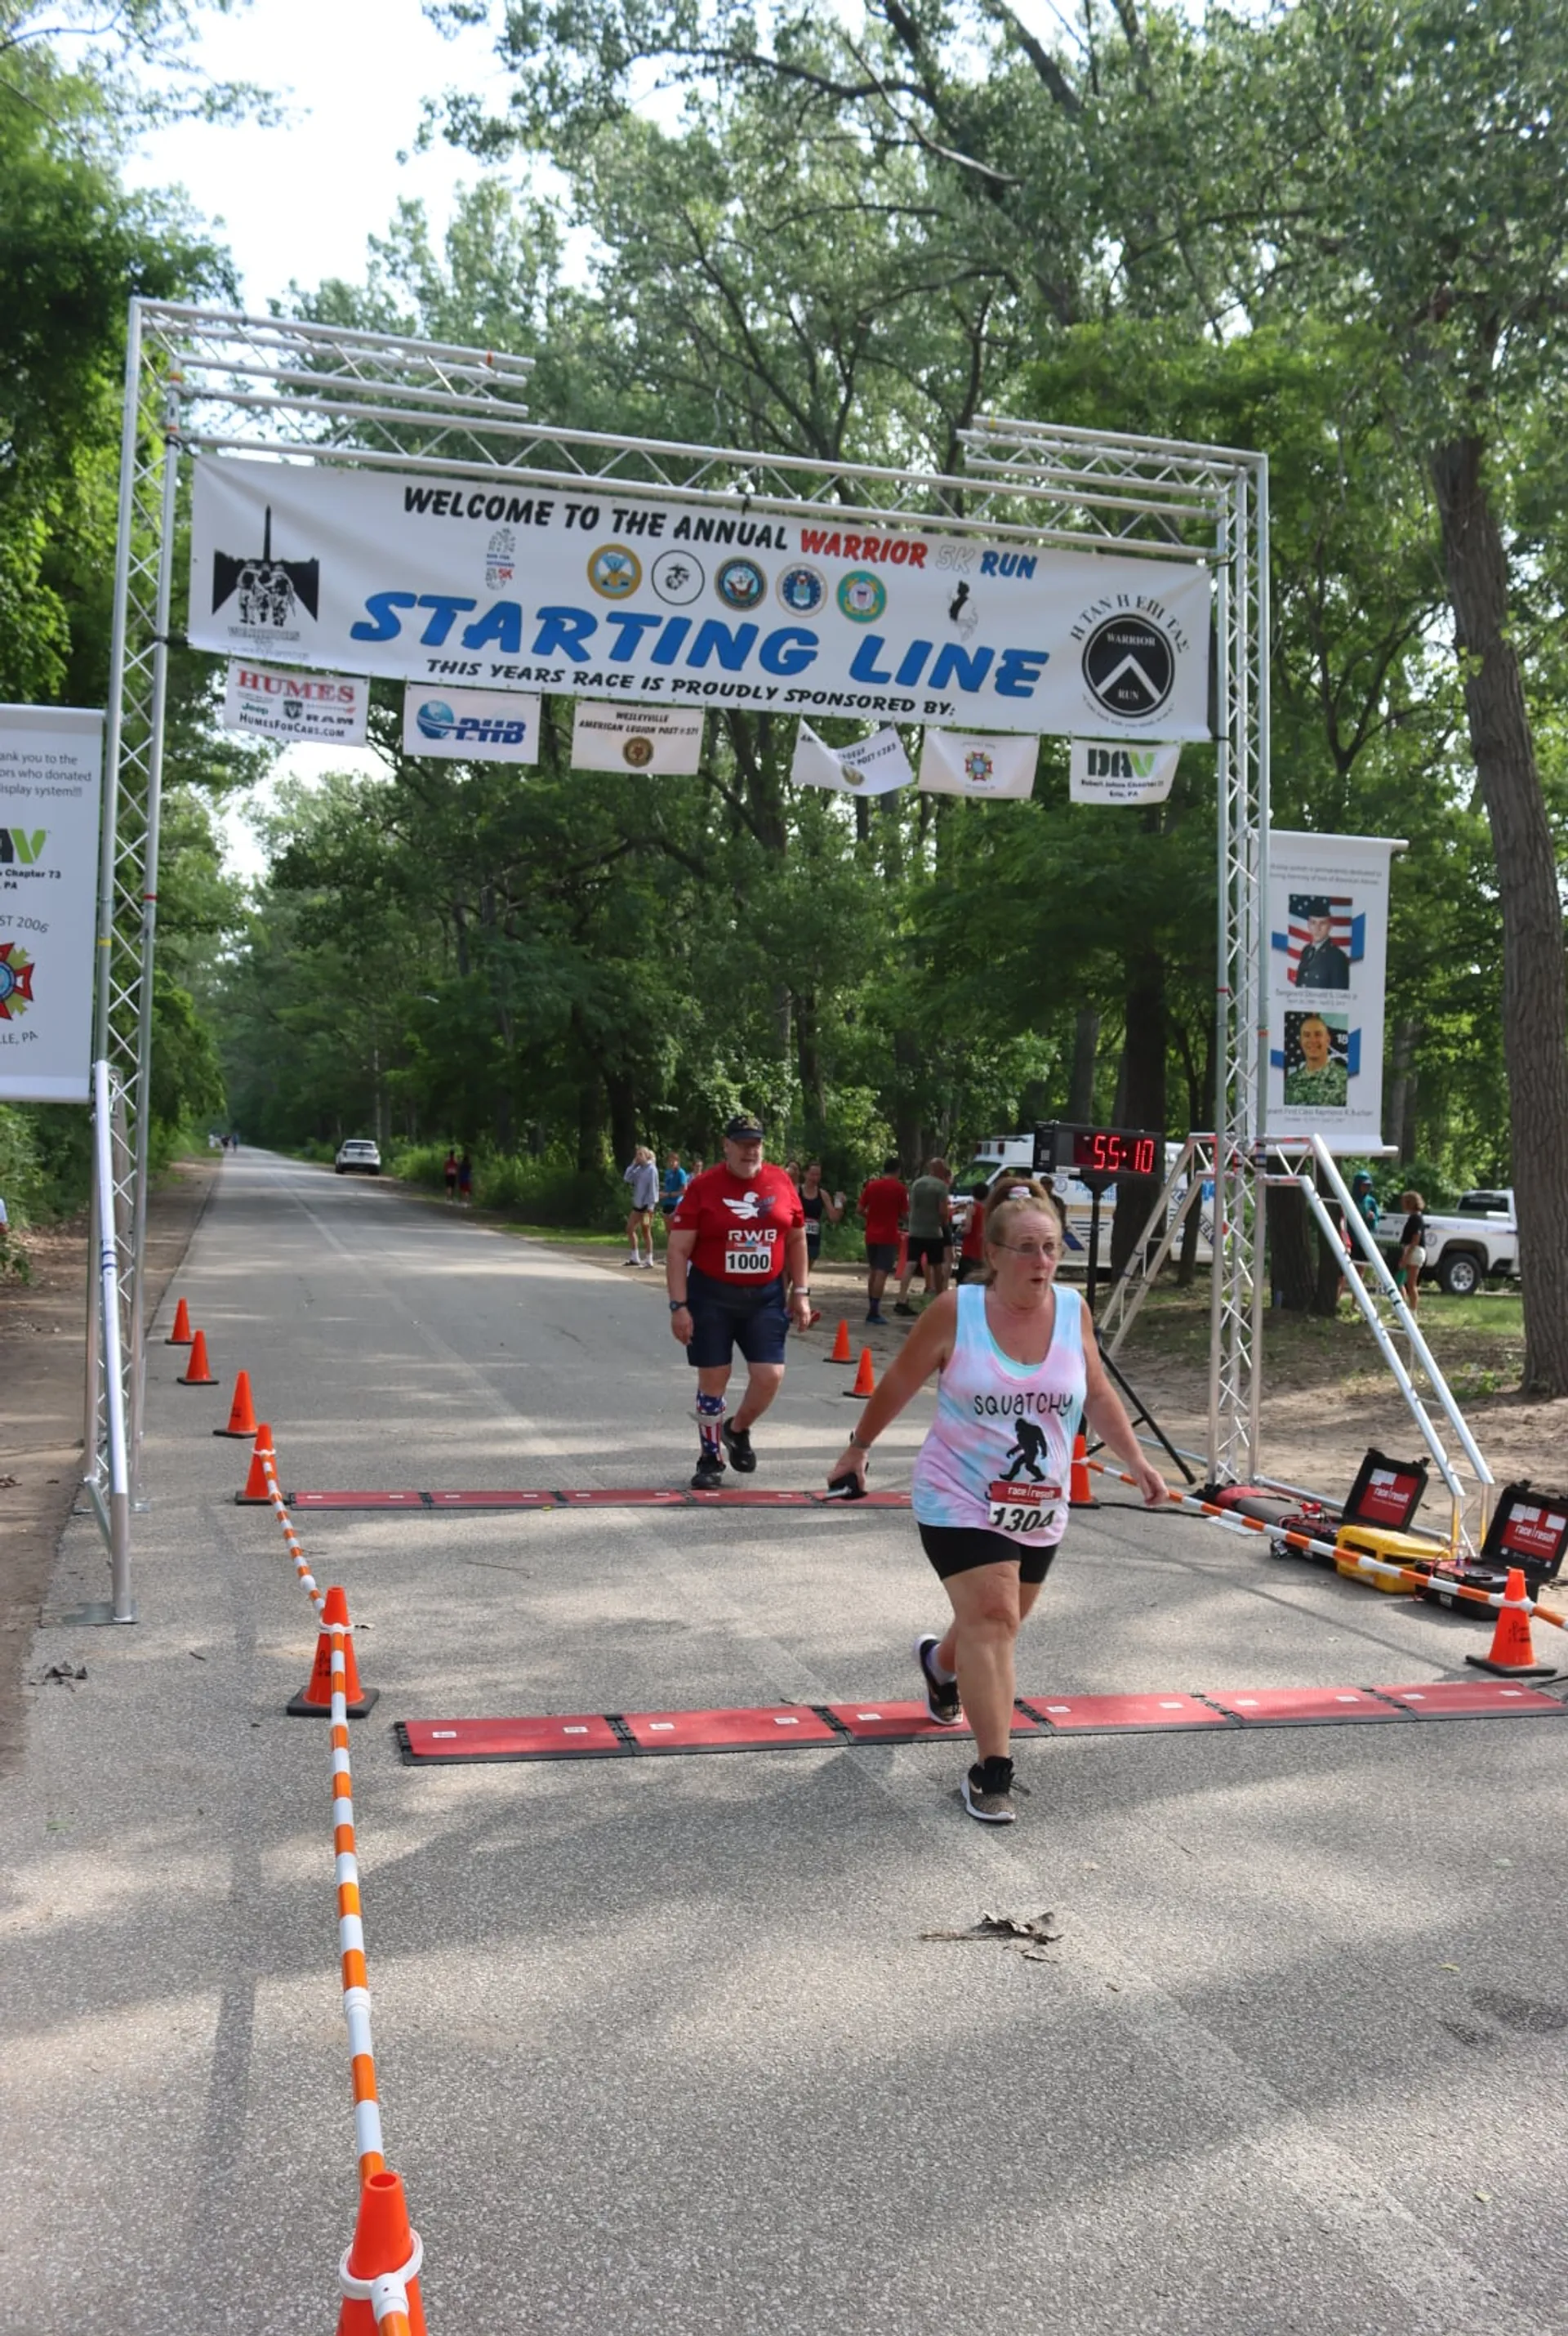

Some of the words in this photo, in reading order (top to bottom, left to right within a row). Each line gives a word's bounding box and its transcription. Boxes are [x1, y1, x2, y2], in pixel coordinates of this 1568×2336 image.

[404, 486, 555, 527] WELCOME
[564, 502, 600, 531] TO
[612, 508, 668, 538] THE
[673, 515, 789, 551] ANNUAL
[800, 528, 929, 569] WARRIOR
[934, 544, 978, 573] 5K
[980, 550, 1039, 580] RUN
[350, 591, 820, 677] STARTING
[849, 633, 1050, 698] LINE
[1107, 632, 1156, 647] WARRIOR
[237, 668, 355, 704] HUMES
[426, 658, 483, 676] THIS
[490, 663, 566, 684] YEARS
[572, 670, 635, 689] RACE
[640, 675, 665, 692] IS
[671, 678, 779, 700] PROUDLY
[783, 688, 916, 713] SPONSORED
[923, 699, 956, 716] BY:
[1118, 689, 1139, 701] RUN
[616, 711, 669, 723] WESLEYVILLE
[579, 720, 624, 733] AMERICAN
[626, 723, 656, 733] LEGION
[658, 726, 679, 736] POST
[21, 754, 42, 765] you
[45, 753, 57, 765] to
[59, 753, 79, 765] the
[1087, 748, 1156, 778] DAV
[18, 768, 43, 780] who
[44, 769, 92, 782] donated
[0, 782, 33, 798] isplay
[5, 868, 46, 879] Chapter
[49, 869, 62, 880] 73
[3, 881, 18, 890] PA
[16, 916, 51, 934] 2006
[21, 1030, 39, 1043] PA
[728, 1228, 777, 1242] RWB
[727, 1253, 769, 1270] 1000
[1008, 1487, 1027, 1496] race
[992, 1507, 1055, 1532] 1304
[1514, 1524, 1533, 1537] race
[1535, 1529, 1557, 1545] result
